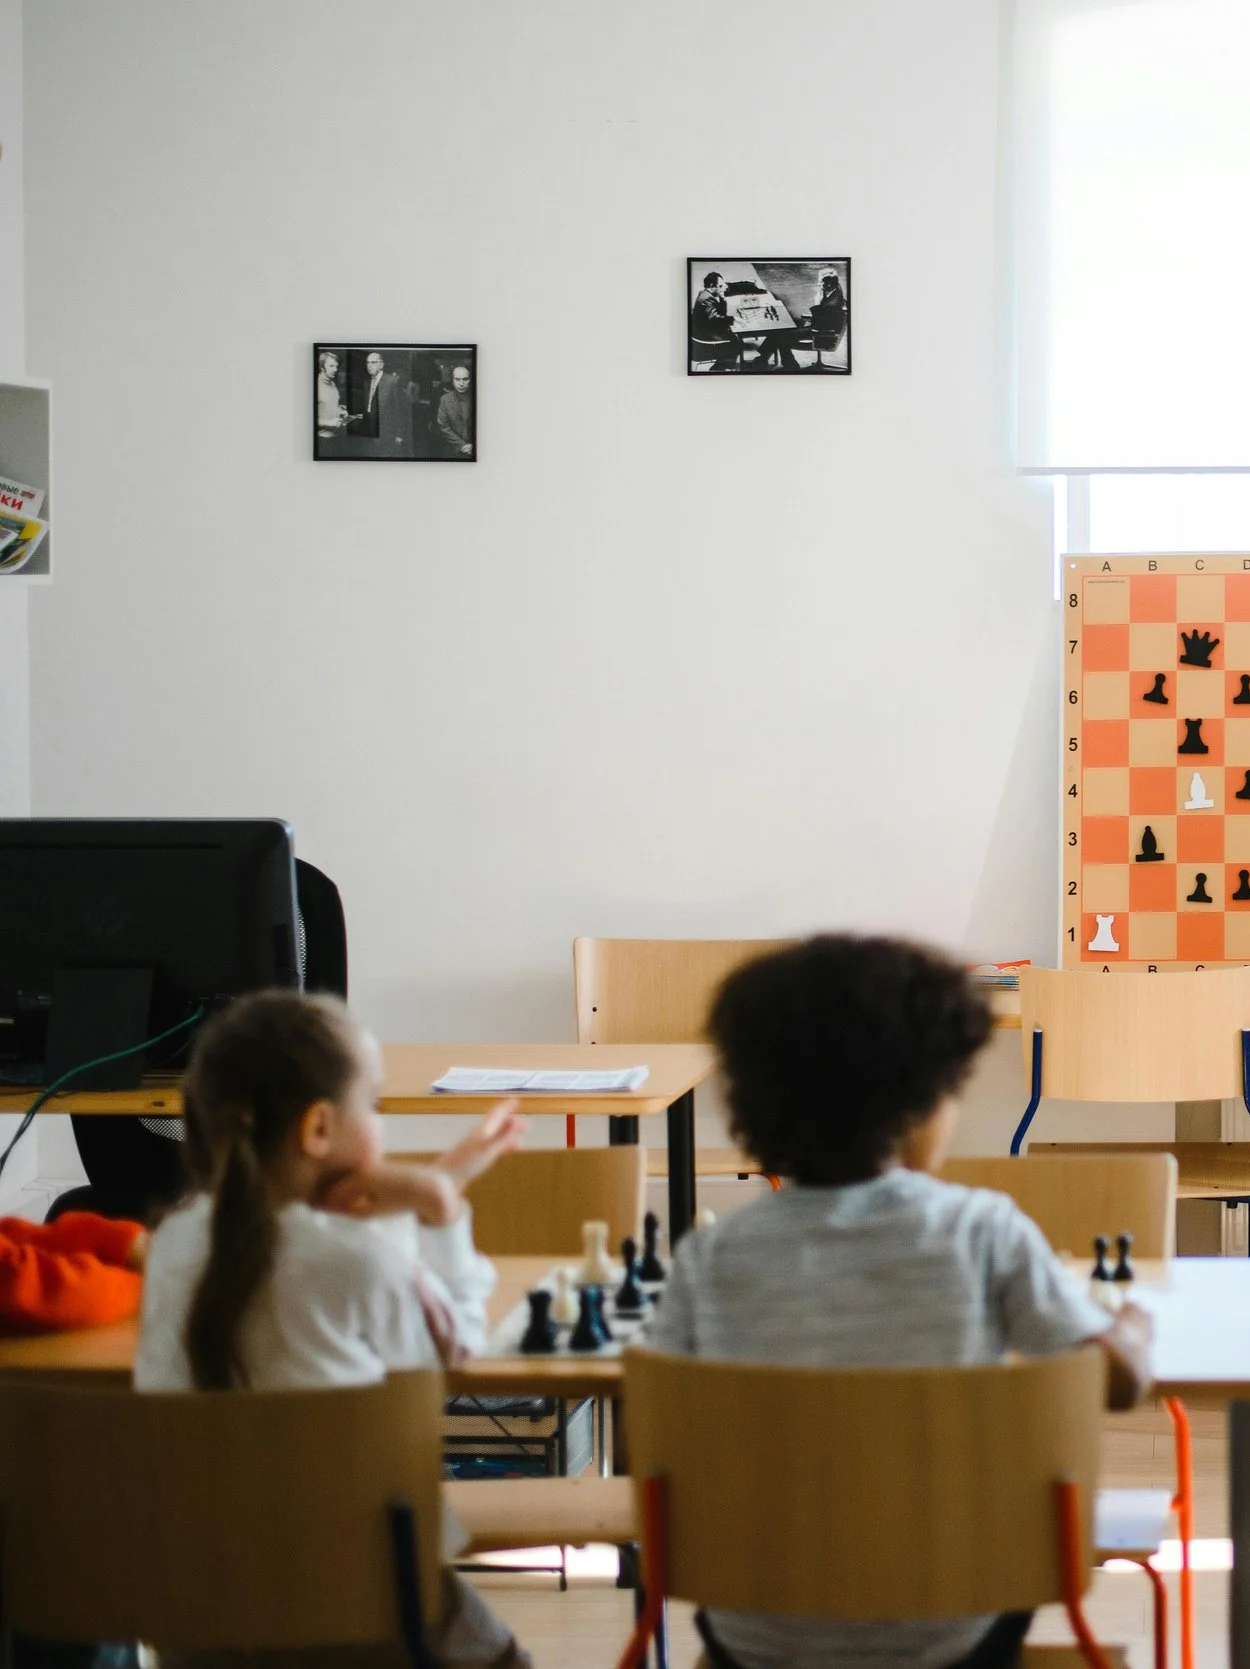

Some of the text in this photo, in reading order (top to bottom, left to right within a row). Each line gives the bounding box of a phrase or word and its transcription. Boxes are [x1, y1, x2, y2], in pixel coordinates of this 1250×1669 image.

[0, 483, 19, 495] вые
[1101, 561, 1112, 572] A
[1148, 560, 1158, 571] B
[1195, 559, 1205, 571] C
[1068, 593, 1078, 608] 8
[1068, 640, 1078, 654] 7
[1068, 690, 1078, 705] 6
[1068, 737, 1078, 752] 5
[1068, 783, 1078, 798] 4
[1068, 832, 1078, 846] 3
[1068, 881, 1078, 895] 2
[1067, 927, 1075, 942] 1
